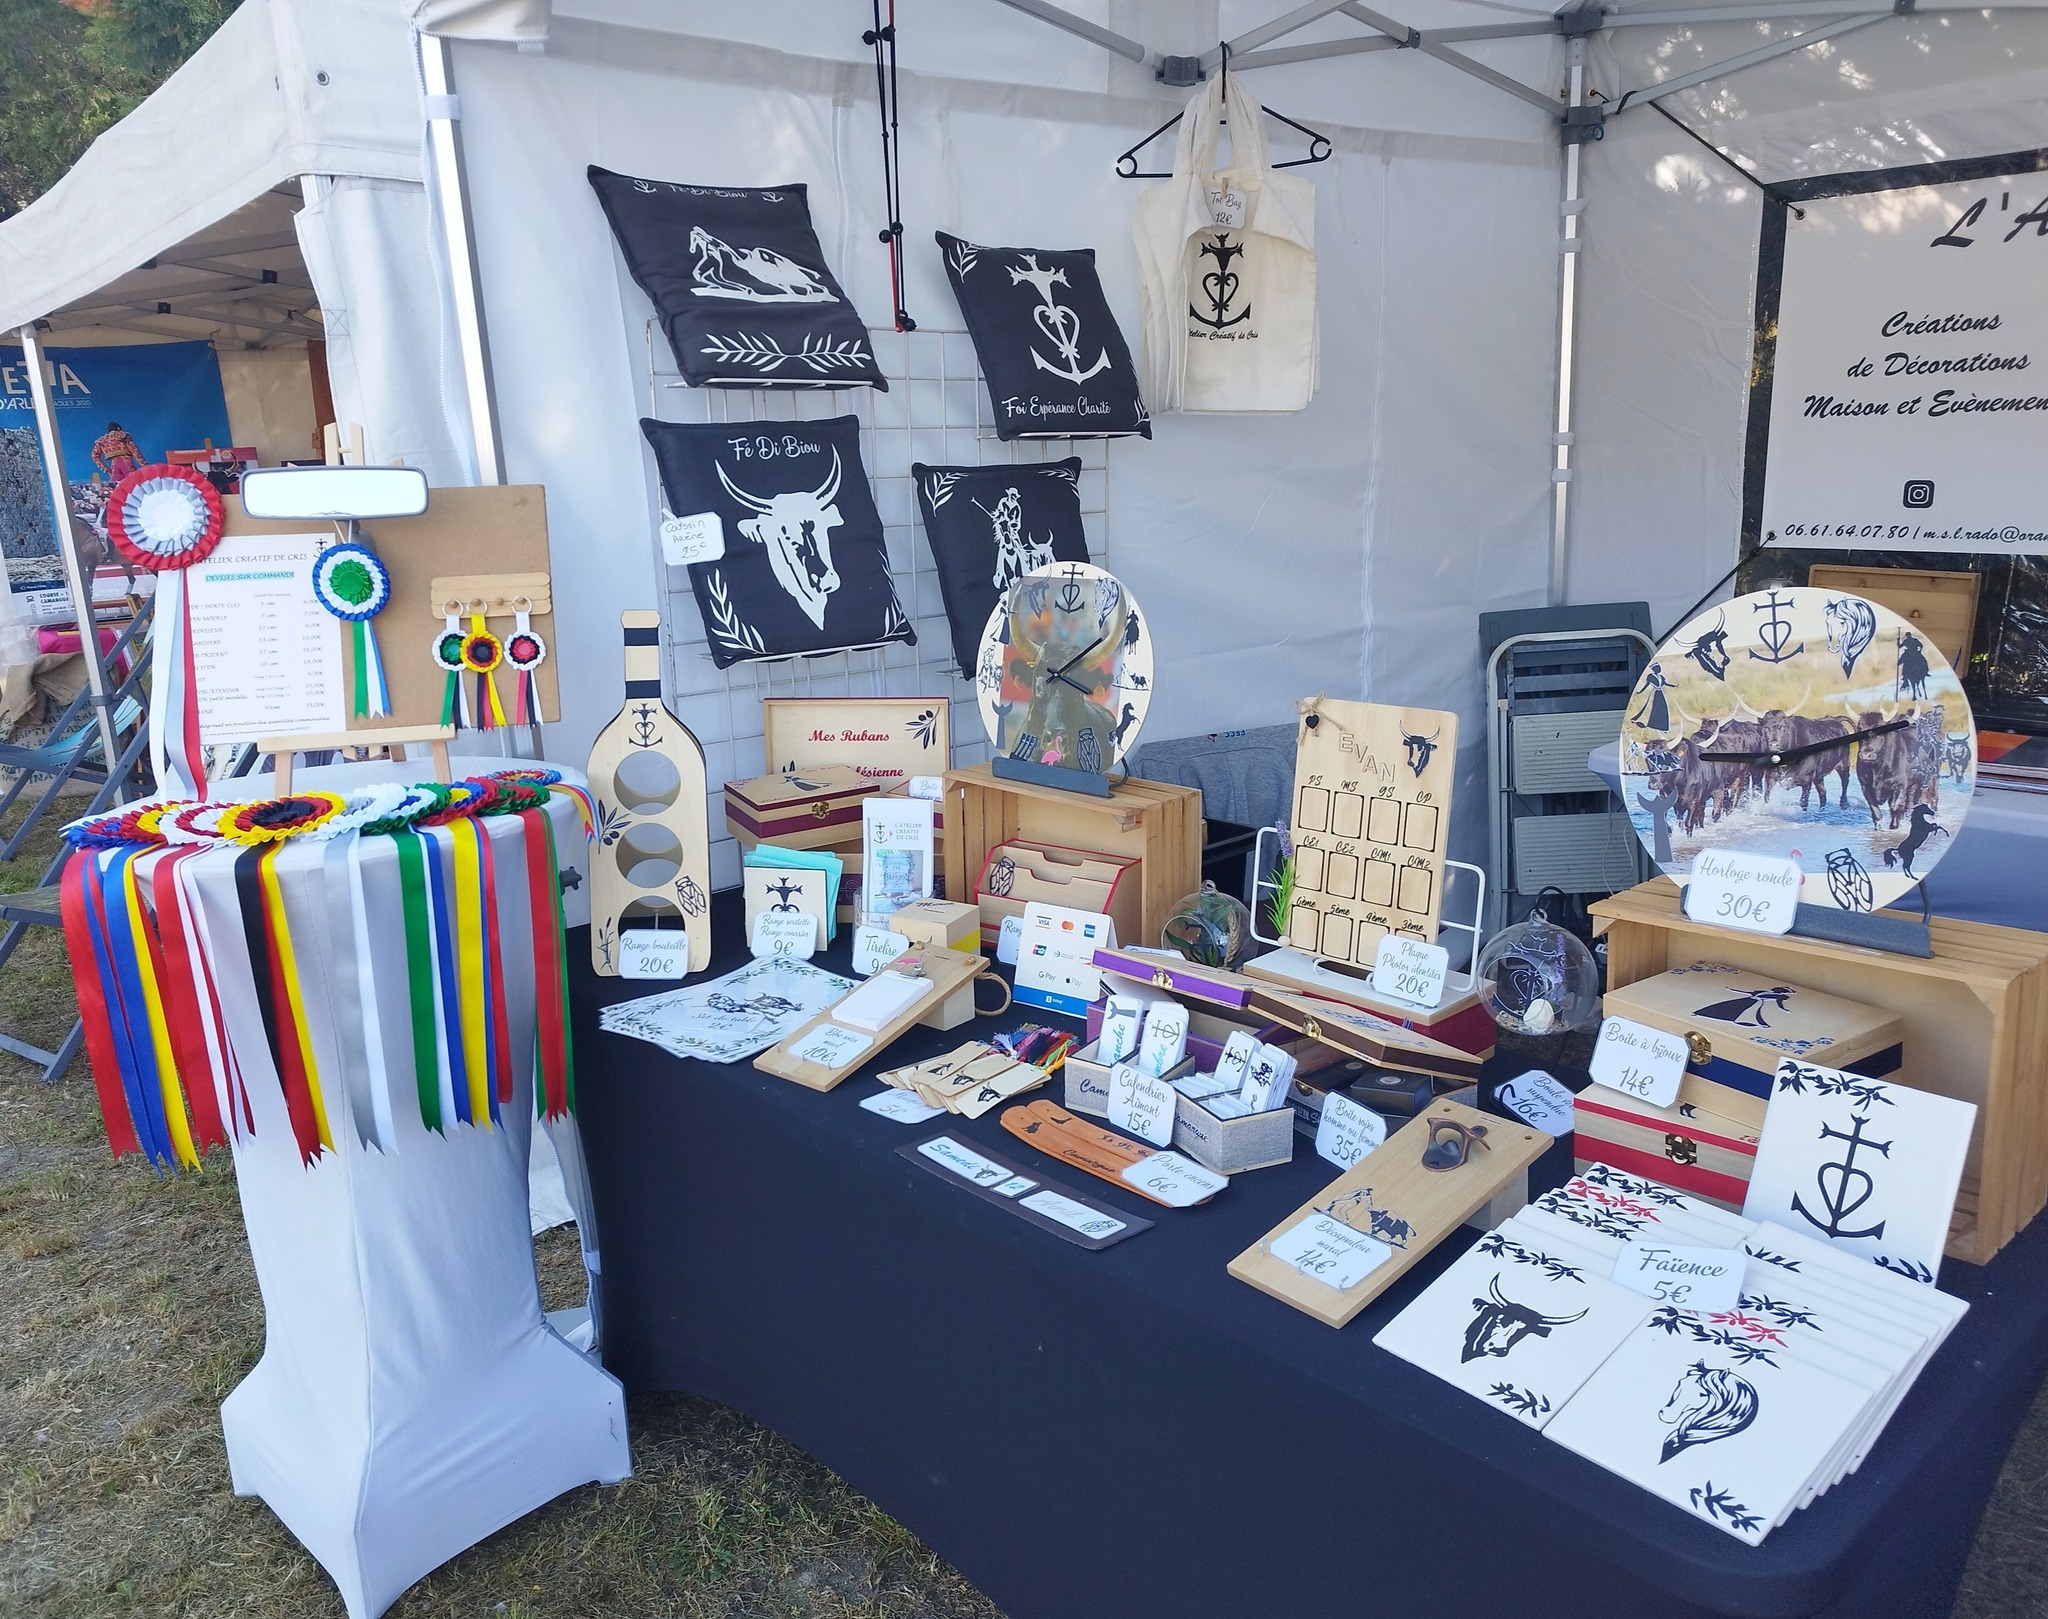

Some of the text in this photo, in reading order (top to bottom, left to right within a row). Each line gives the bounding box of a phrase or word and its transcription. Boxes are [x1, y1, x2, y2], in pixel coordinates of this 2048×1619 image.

[1225, 193, 1242, 209] Bag
[1215, 212, 1233, 225] 12€
[1188, 328, 1259, 342] telier Créatif de Cris
[1881, 310, 2003, 337] Créations
[1847, 352, 2031, 378] de Décorations
[1001, 396, 1112, 421] Foi Espérance Charité
[1803, 394, 1890, 419] Maison
[1896, 396, 1922, 415] et
[727, 435, 821, 461] Fé Di Biou
[1785, 523, 1909, 539] 06.61.64.07.80
[274, 554, 285, 562] DE
[288, 553, 308, 561] CRIS
[206, 574, 235, 582] DEVISES
[253, 572, 295, 580] COMMANDE
[808, 729, 890, 742] Mes Rubans
[1338, 732, 1396, 783] EVAN
[1308, 775, 1324, 786] PS
[1415, 790, 1433, 804] CP
[1335, 840, 1357, 855] CE2
[1370, 847, 1392, 861] CM1
[1407, 855, 1431, 870] CM2
[1700, 856, 1796, 886] Horloge ronde
[1330, 903, 1351, 916] 5ème
[1365, 910, 1388, 925] 4ème
[1401, 917, 1425, 932] 3ème
[1716, 892, 1771, 922] 30€
[761, 925, 782, 938] Range
[763, 914, 784, 927] Range
[622, 937, 687, 953] Range bouteille
[772, 939, 794, 956] 9€
[866, 935, 898, 957] Tirelire
[1401, 941, 1430, 961] Plaque
[639, 956, 674, 974] 20€
[1382, 953, 1441, 981] Photos identités
[1395, 973, 1430, 998] 20€
[1605, 1022, 1638, 1047] Boite
[1640, 1038, 1650, 1050] à
[803, 1046, 838, 1062] 10€
[1119, 1068, 1169, 1103] Calendrier
[1533, 1076, 1566, 1099] Boule
[1620, 1066, 1655, 1096] 14€
[1122, 1090, 1161, 1118] Aimant
[1335, 1099, 1359, 1122] Boite
[1511, 1098, 1548, 1122] 16€
[1526, 1088, 1567, 1117] suspendue
[1127, 1110, 1152, 1136] 15€
[1323, 1108, 1348, 1132] homme
[1347, 1128, 1359, 1138] ou
[929, 1144, 980, 1170] Samedi
[1331, 1135, 1362, 1166] 35€
[1152, 1154, 1215, 1190] Porte encens
[1005, 1181, 1026, 1191] 12
[1147, 1177, 1178, 1193] 6€
[1315, 1220, 1373, 1254] Décapsuleur
[1316, 1240, 1352, 1257] mural
[1295, 1249, 1337, 1274] 14€
[1639, 1247, 1728, 1277] Faïence
[1648, 1280, 1692, 1304] 5€
